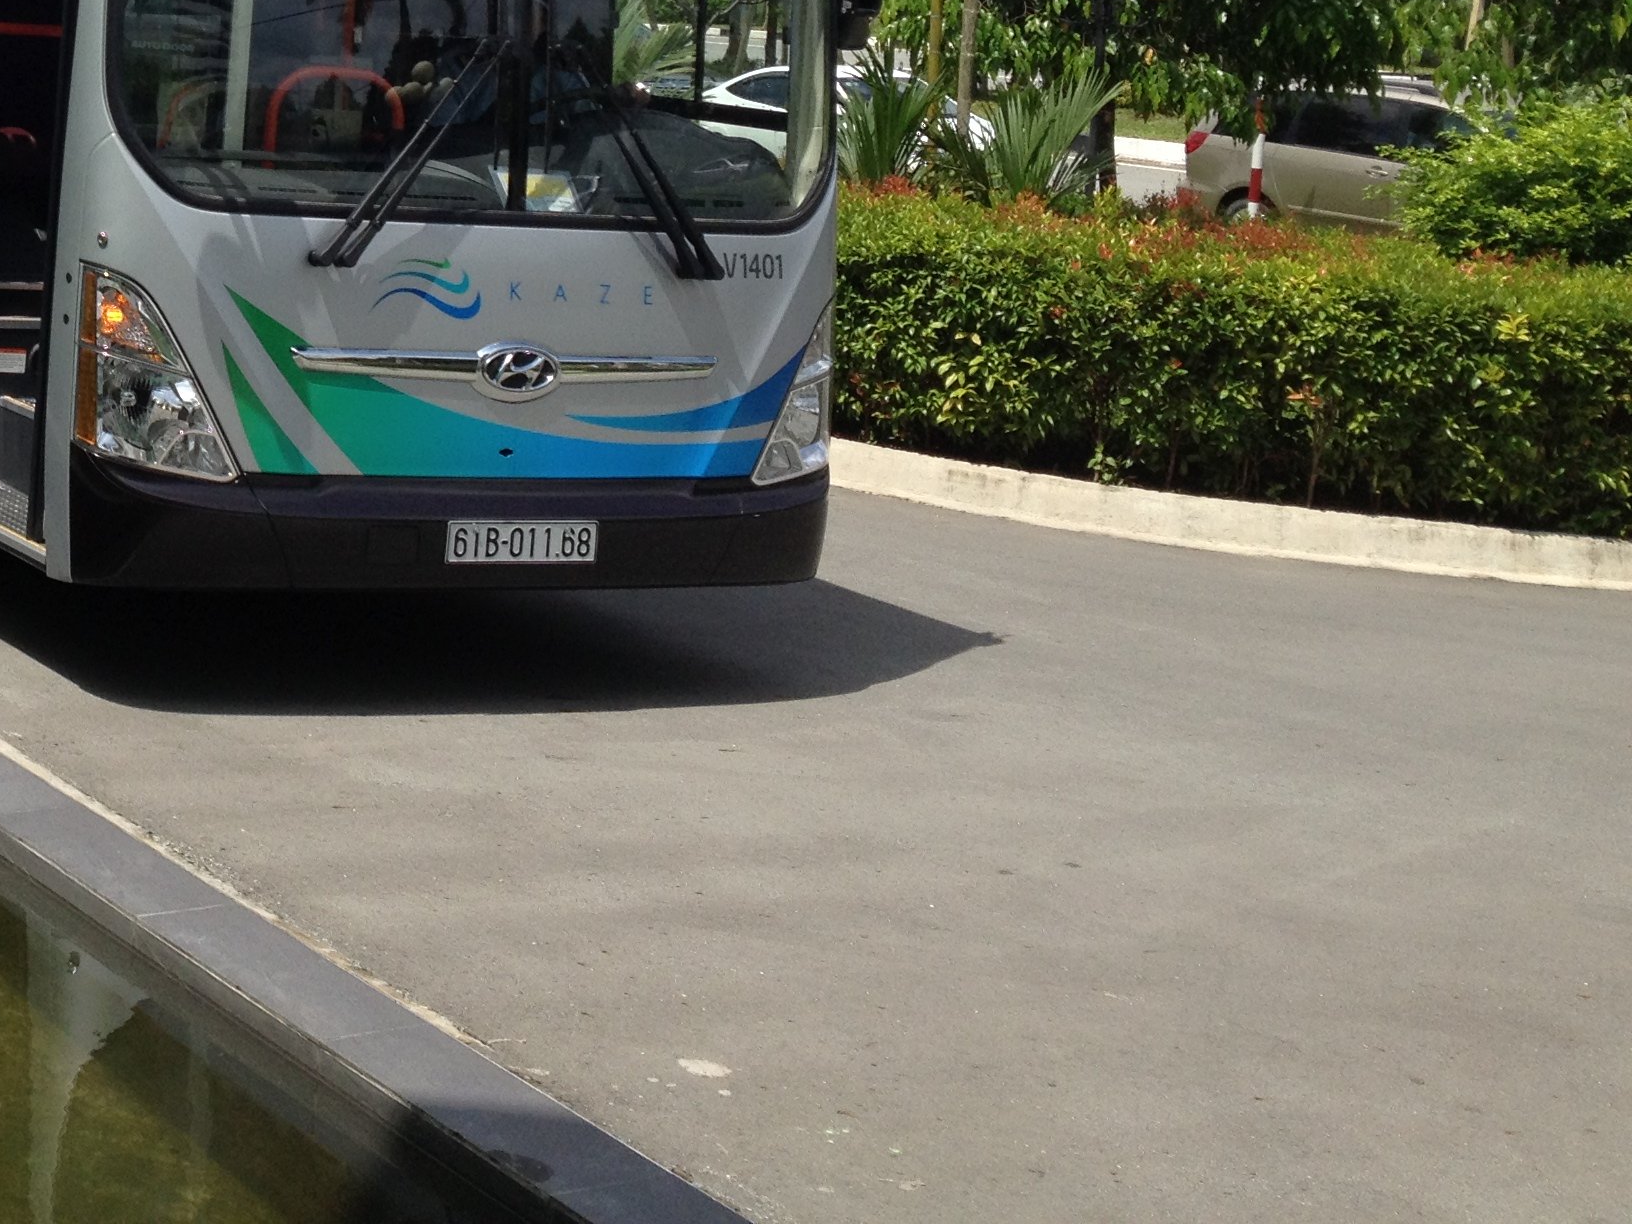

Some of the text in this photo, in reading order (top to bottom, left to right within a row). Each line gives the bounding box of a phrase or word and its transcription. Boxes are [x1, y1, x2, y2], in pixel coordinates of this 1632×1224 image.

[723, 252, 783, 279] V1401
[510, 281, 653, 305] KAZE
[453, 527, 591, 557] 61B-011.68
